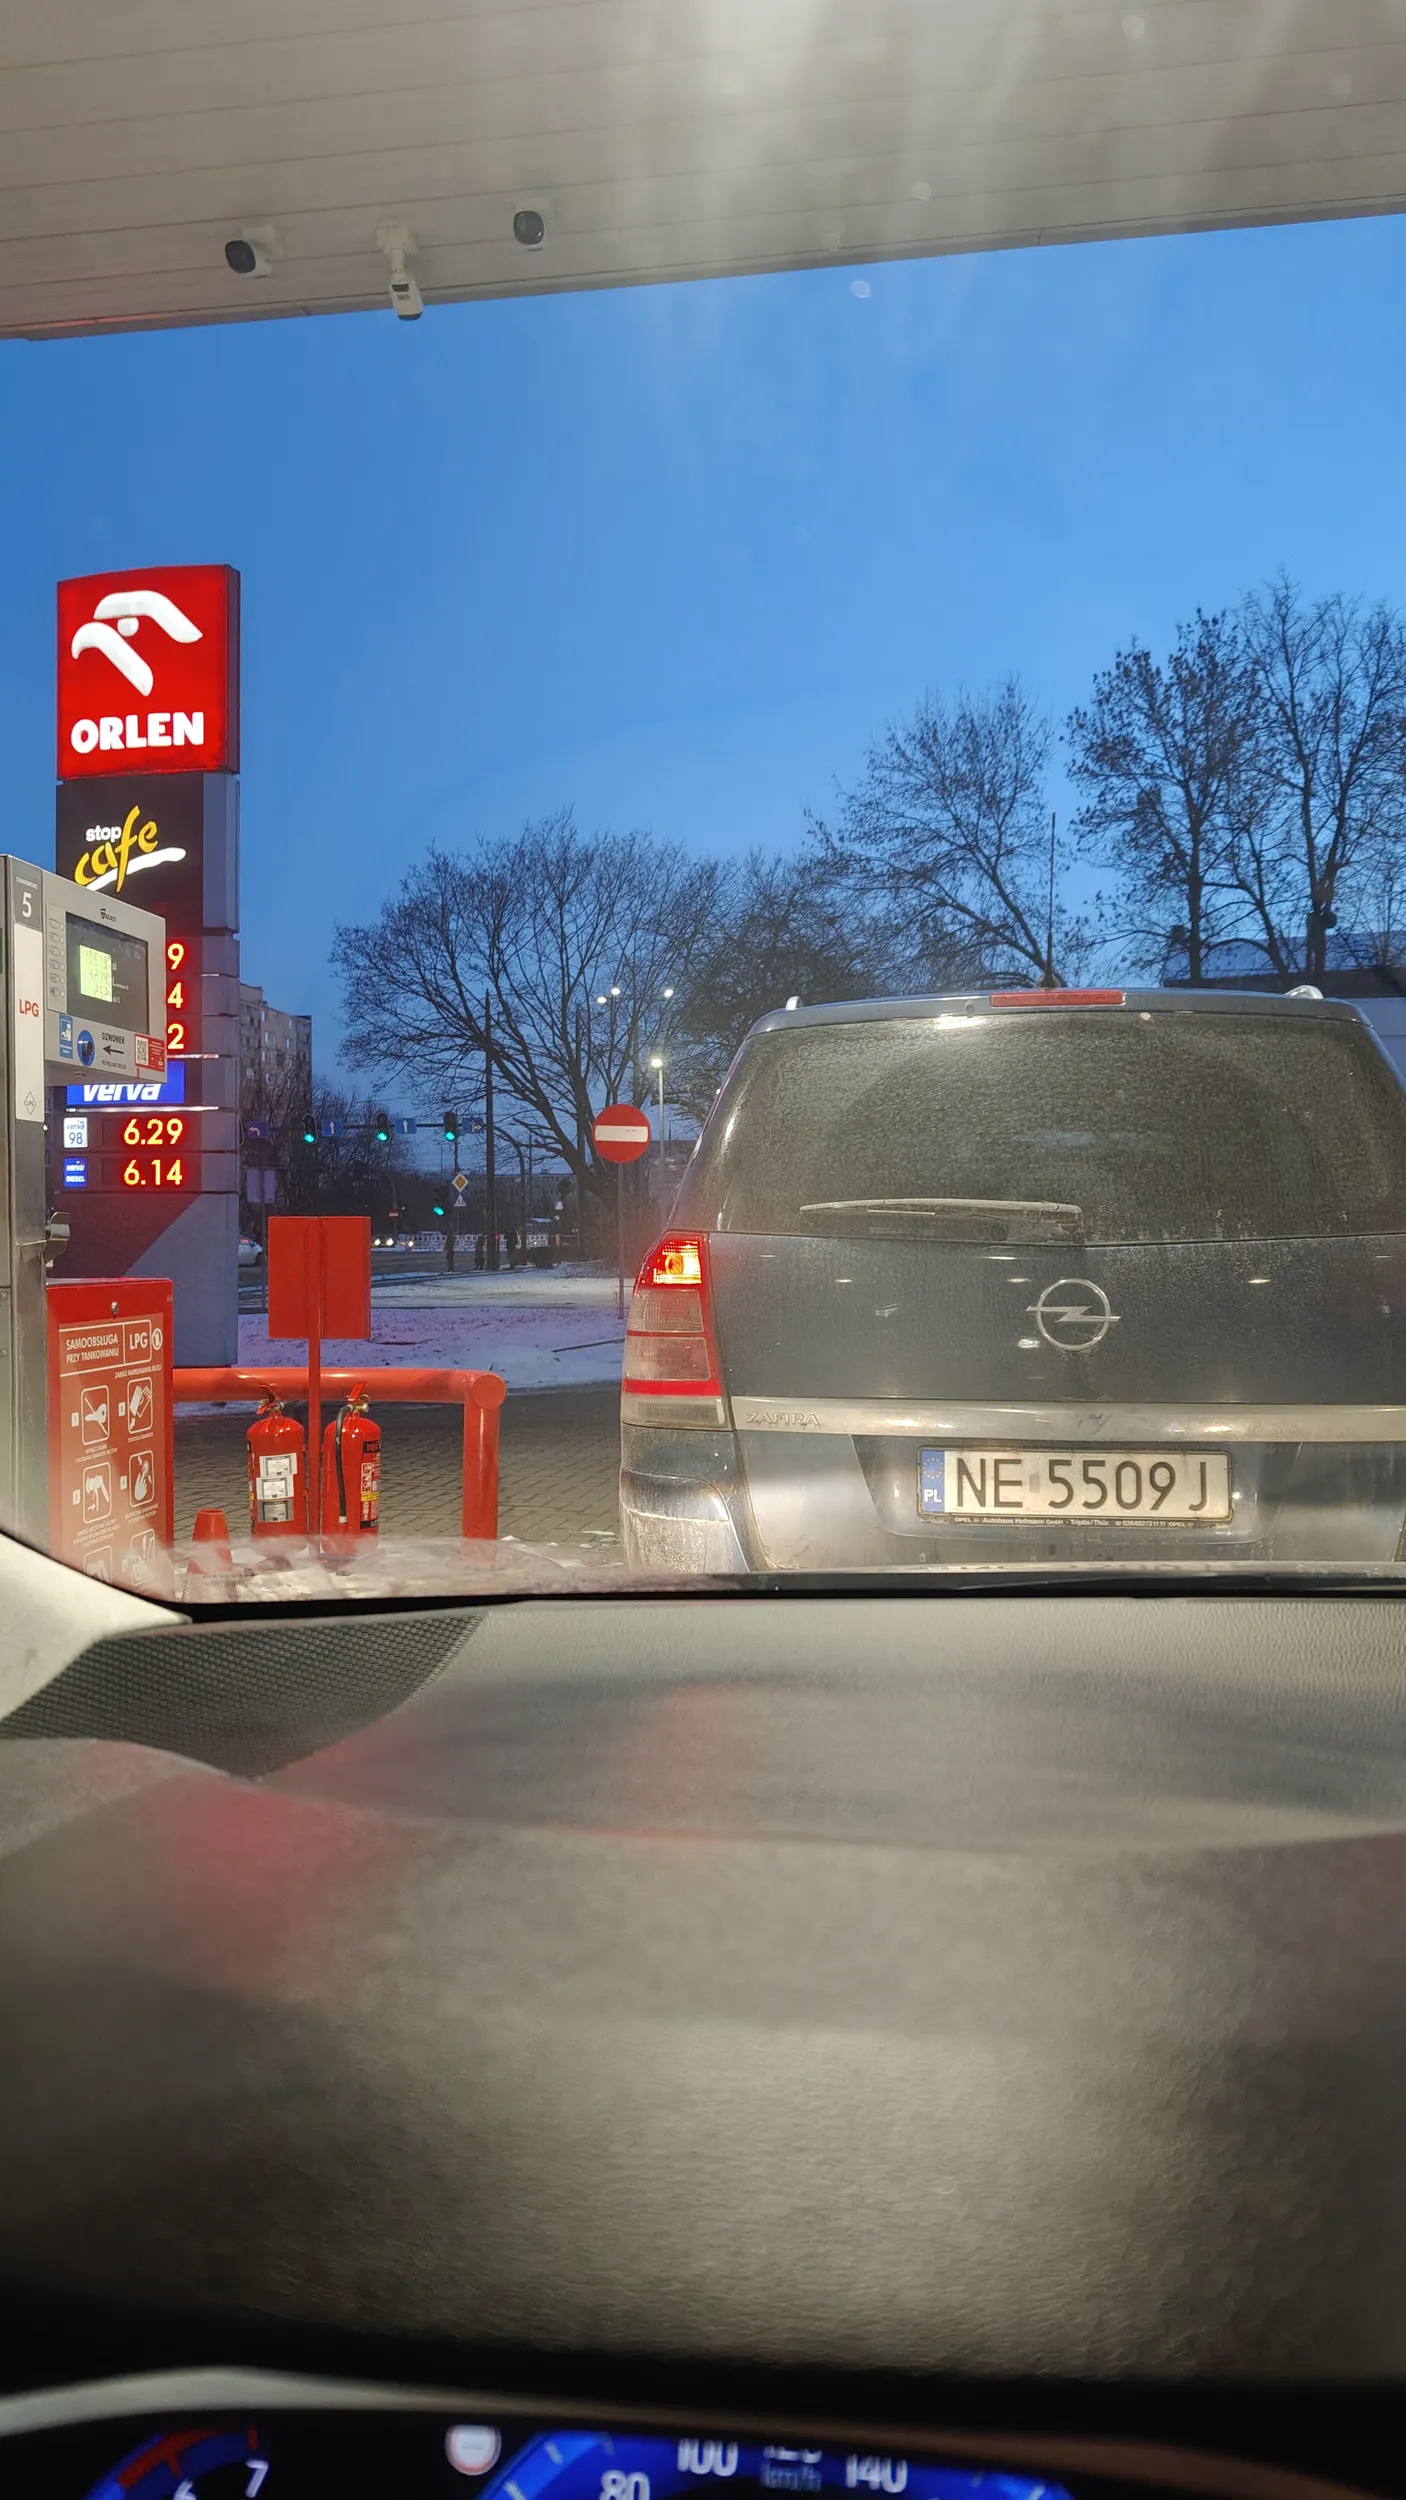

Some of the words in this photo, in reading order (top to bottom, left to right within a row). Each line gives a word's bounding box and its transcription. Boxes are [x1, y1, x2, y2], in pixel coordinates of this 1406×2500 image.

[71, 711, 204, 754] ORLEN
[85, 824, 122, 842] stop
[74, 804, 159, 893] cafe
[21, 891, 32, 918] 5
[19, 998, 39, 1018] LPG
[101, 1032, 126, 1045] DZWONEK
[83, 1084, 162, 1102] verva
[69, 1132, 83, 1145] 98
[124, 1118, 183, 1145] 6.29
[124, 1159, 183, 1186] 6.14
[66, 1333, 119, 1351] SAMOOBSŁUGA
[129, 1331, 148, 1350] LPG
[66, 1352, 80, 1364] PRZY
[81, 1347, 119, 1362] TANKOWANIU
[746, 1411, 821, 1427] ZAFIRA
[924, 1489, 942, 1503] PL
[957, 1458, 1023, 1508] NE
[244, 2458, 269, 2499] 7
[677, 2437, 739, 2477] 100
[845, 2454, 908, 2494] 140
[598, 2469, 651, 2500] 80
